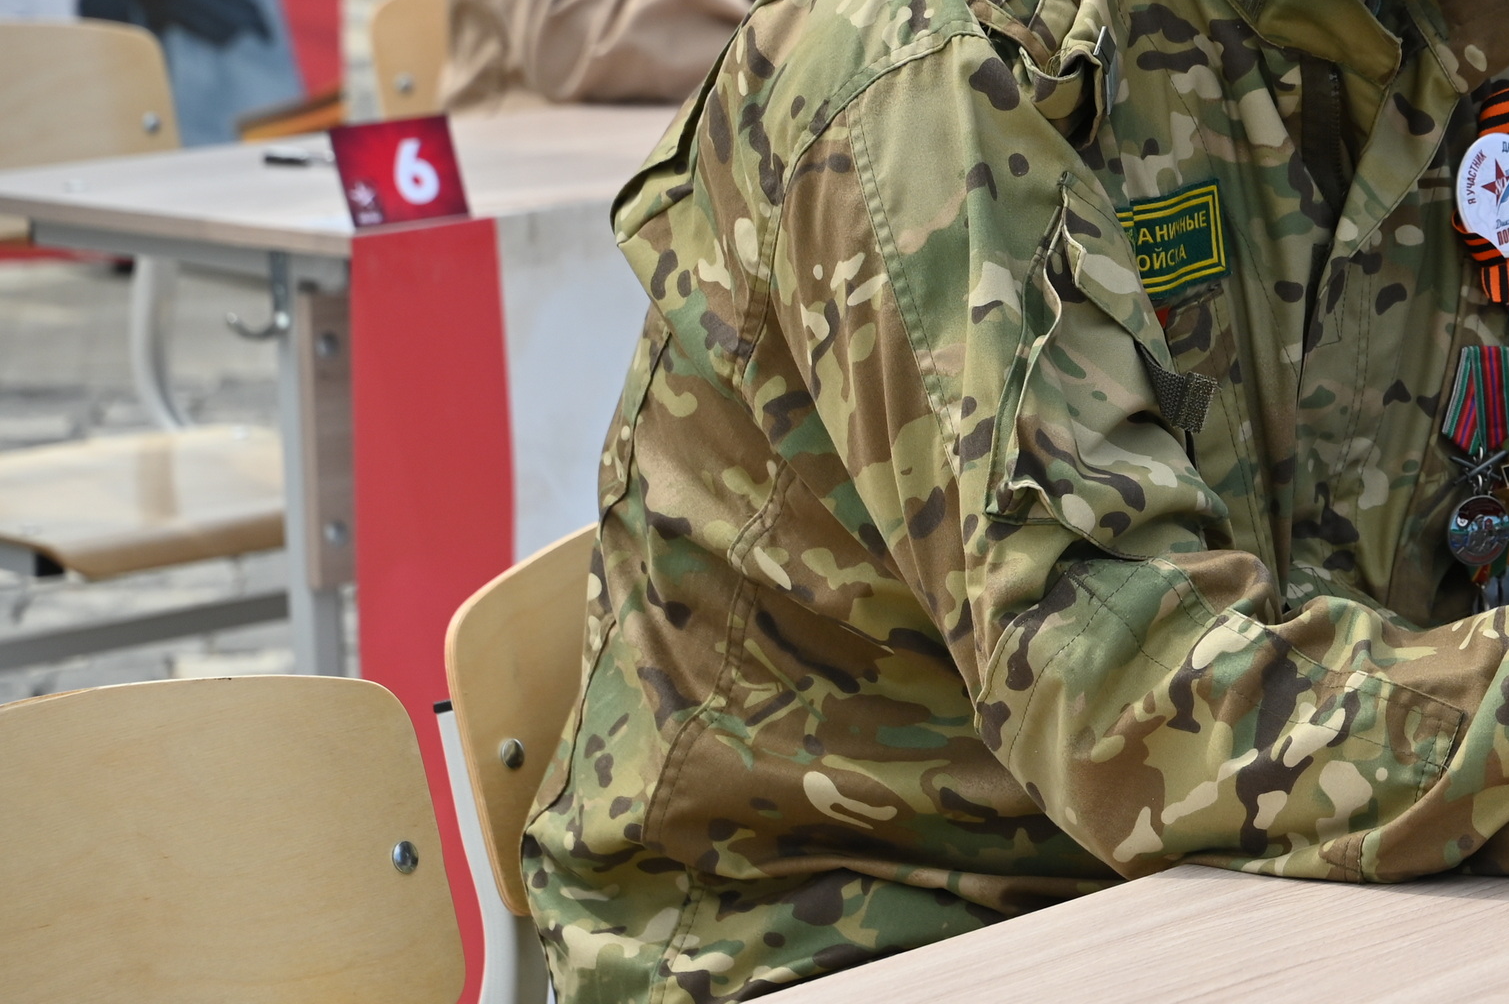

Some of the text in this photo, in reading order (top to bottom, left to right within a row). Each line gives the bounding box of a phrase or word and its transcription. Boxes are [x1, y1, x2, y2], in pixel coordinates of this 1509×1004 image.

[393, 136, 440, 205] 6
[1466, 149, 1487, 197] УЧАСТНИК
[1137, 210, 1207, 245] АНИЧНЫЕ
[1136, 243, 1187, 272] ОЙСКА
